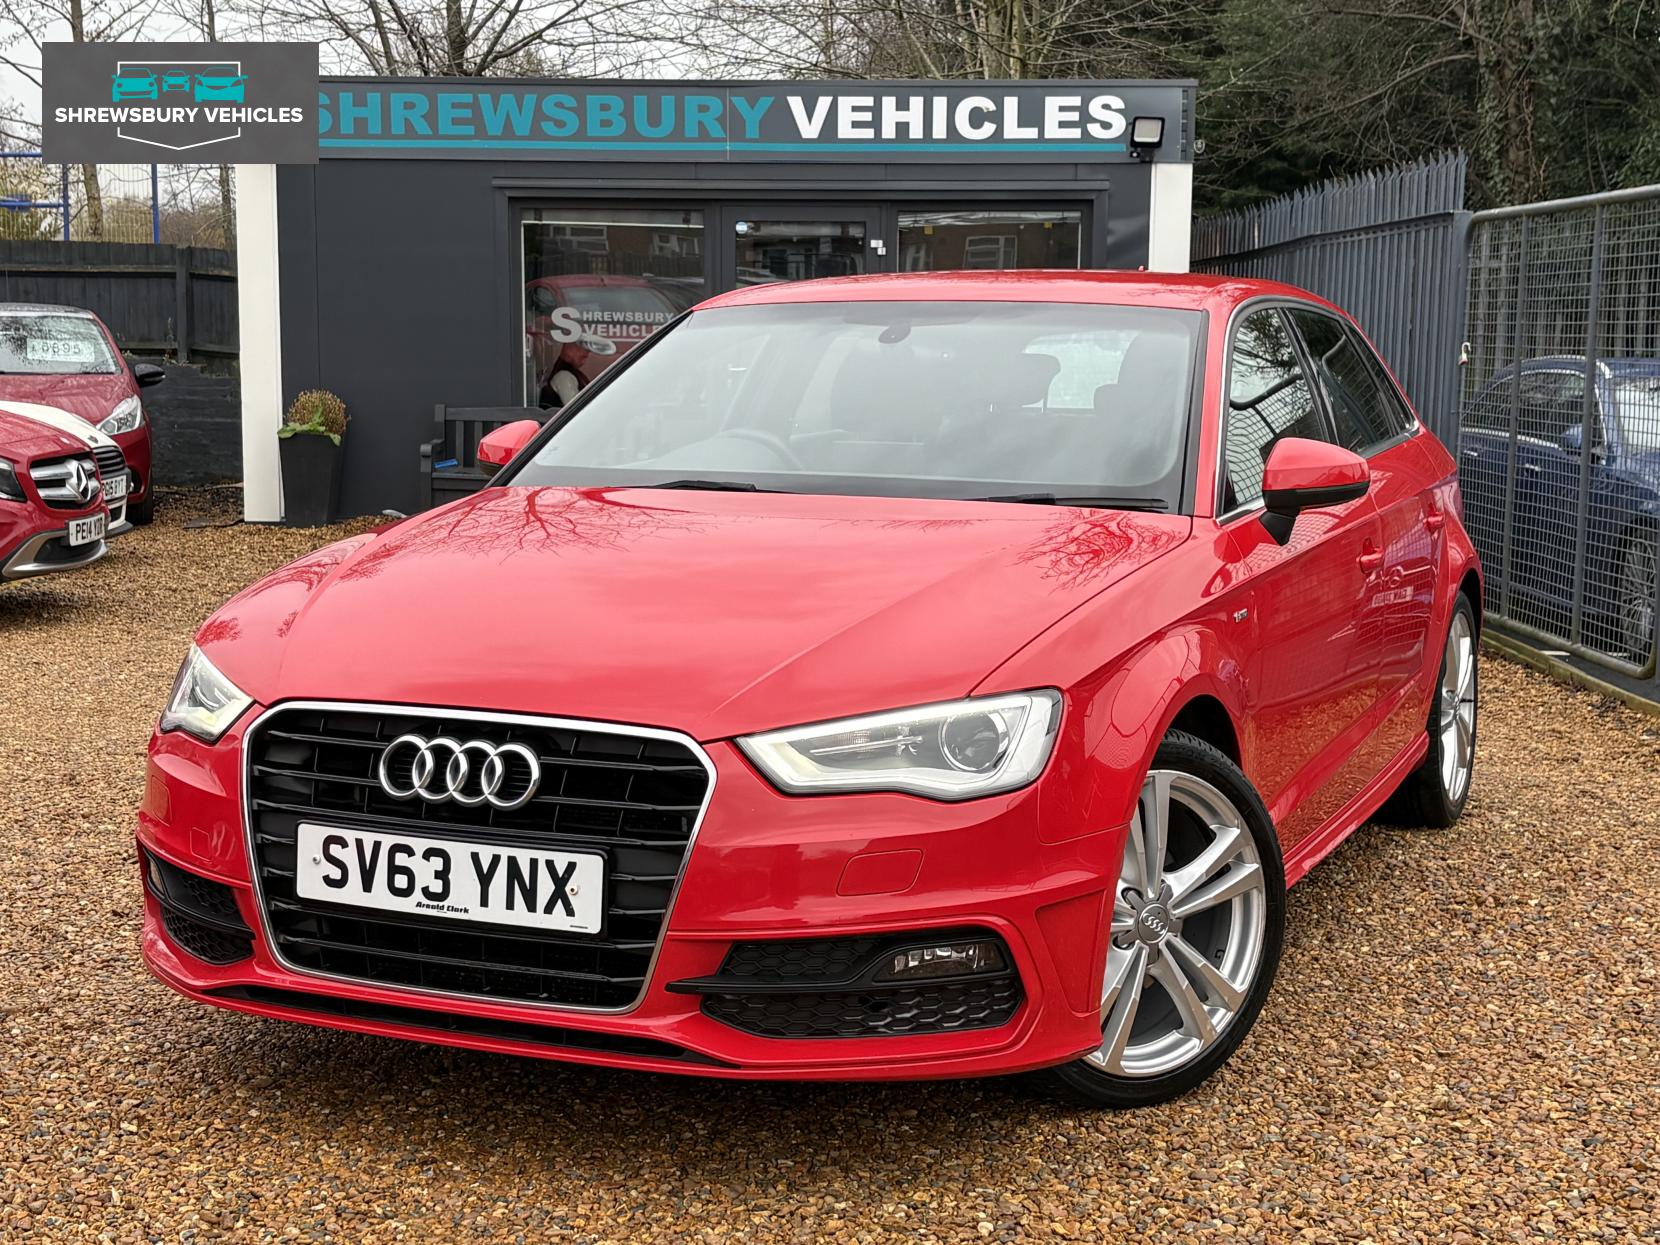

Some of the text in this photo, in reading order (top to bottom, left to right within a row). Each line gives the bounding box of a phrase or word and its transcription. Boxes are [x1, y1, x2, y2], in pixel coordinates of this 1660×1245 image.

[787, 96, 1127, 140] VEHICLES
[322, 834, 577, 918] SV63 YNX
[415, 901, 445, 911] Arnold
[446, 905, 470, 914] Clark
